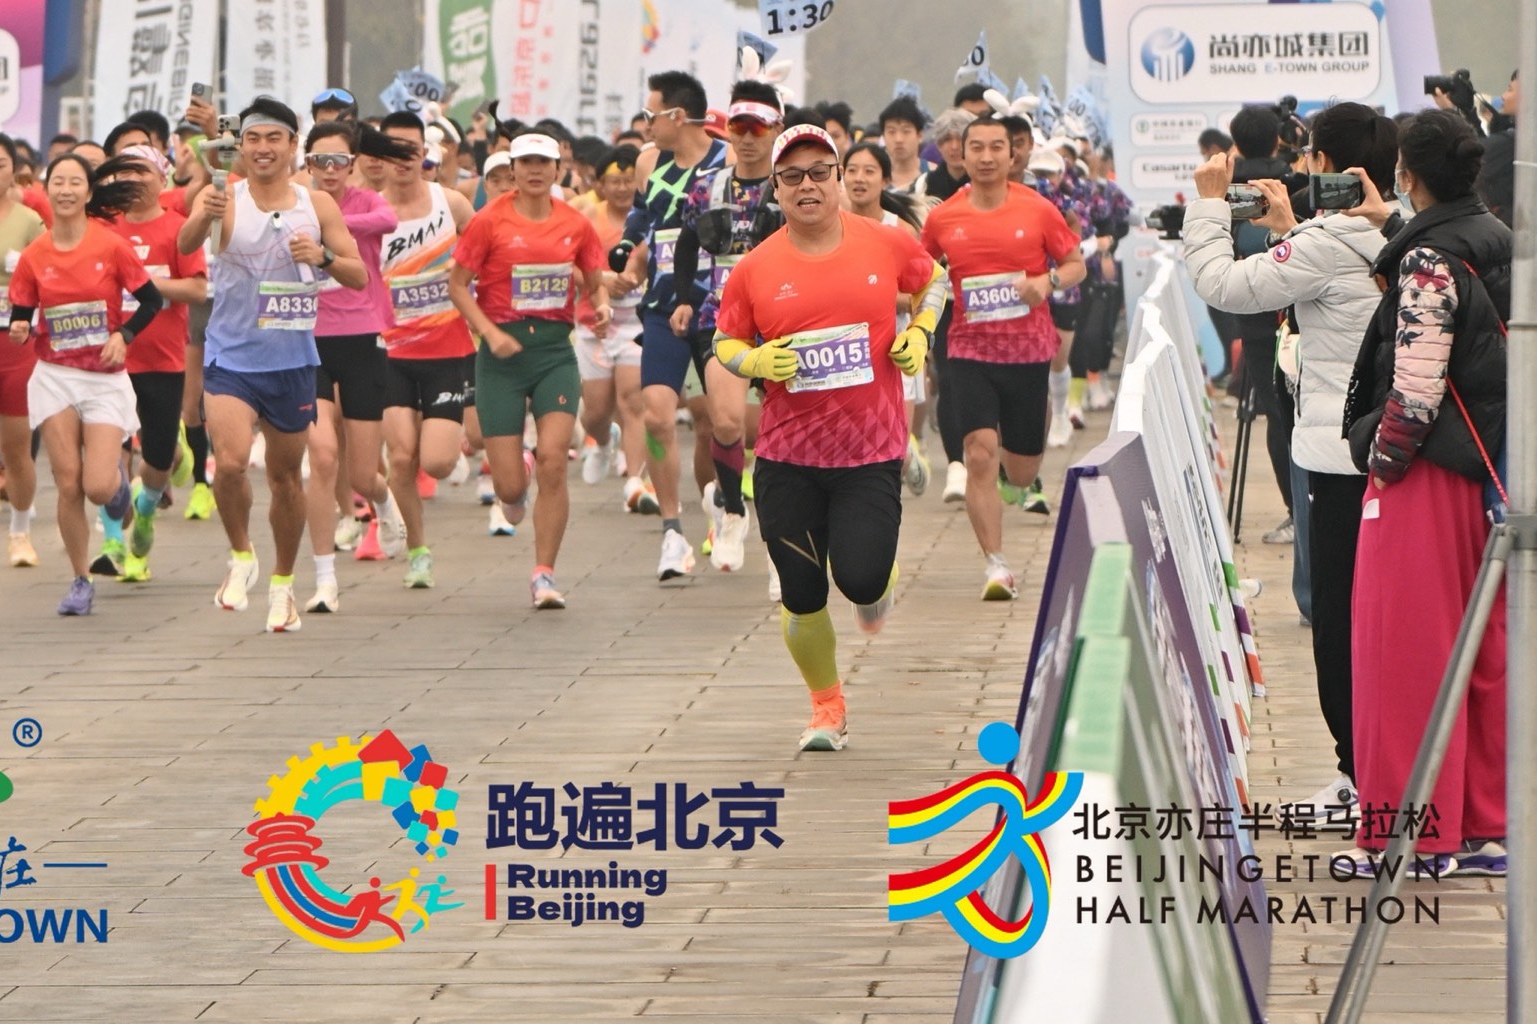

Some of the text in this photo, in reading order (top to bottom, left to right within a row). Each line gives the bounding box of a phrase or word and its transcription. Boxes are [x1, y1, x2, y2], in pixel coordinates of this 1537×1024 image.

[767, 0, 834, 35] 1:30
[1210, 31, 1368, 58] 尚亦城集团
[1210, 61, 1369, 74] SHANG E-TOWN GROUP
[398, 282, 450, 304] A3532
[520, 277, 569, 294] B2129
[53, 314, 102, 333] B0006
